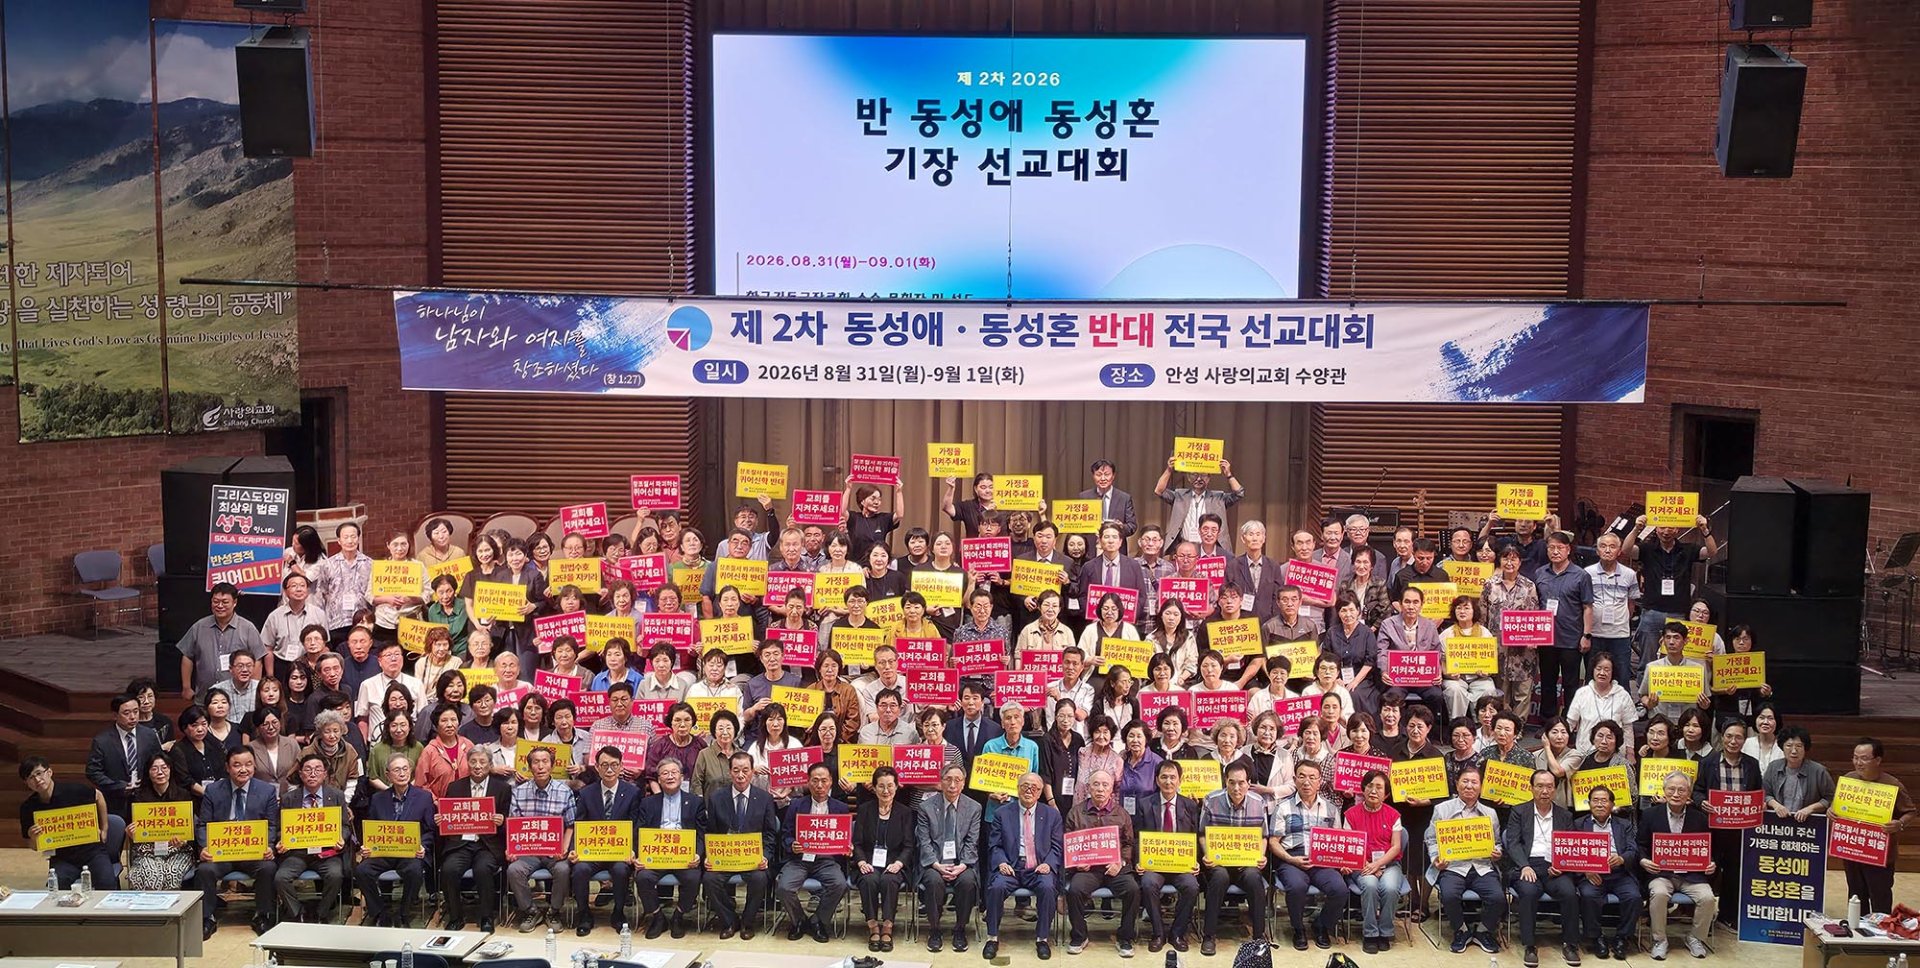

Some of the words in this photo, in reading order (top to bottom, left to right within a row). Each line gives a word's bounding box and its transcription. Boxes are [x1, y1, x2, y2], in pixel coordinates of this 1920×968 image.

[956, 71, 972, 87] 제
[979, 71, 1006, 87] 2차
[1012, 72, 1061, 87] 2026
[856, 98, 892, 137] 반
[910, 98, 1023, 138] 동성애
[1044, 98, 1159, 139] 동성혼
[884, 146, 959, 186] 기장
[978, 147, 1129, 186] 선교대회
[46, 261, 132, 287] 제자되어
[46, 296, 133, 321] 실천하는
[417, 304, 485, 323] 하나님이
[730, 309, 763, 344] 제
[772, 310, 828, 345] 2차
[844, 310, 944, 347] 동성애
[979, 312, 1079, 347] 동성혼
[1089, 312, 1154, 348] 반대
[1164, 313, 1231, 349] 전국
[1240, 313, 1375, 349] 선교대회
[17, 339, 38, 349] that
[42, 337, 70, 348] Lives
[107, 335, 132, 345] Love
[198, 332, 243, 343] Disciples
[245, 332, 254, 340] of
[435, 323, 518, 352] 남자와
[525, 327, 587, 358] 여자를
[512, 359, 599, 381] 창조하셨다
[704, 362, 737, 380] 일시
[758, 364, 819, 382] 2026년
[824, 364, 851, 382] 8월
[856, 365, 961, 384] 31일(월)-9월
[967, 365, 1025, 385] 1일(화)
[604, 374, 617, 386] (창
[619, 374, 641, 386] 1:27)
[1110, 367, 1144, 384] 장소
[1165, 367, 1199, 384] 안성
[1204, 367, 1290, 385] 사랑의교회
[1295, 367, 1347, 385] 수양관
[223, 405, 275, 418] 사랑의교회
[223, 419, 248, 427] SaRang
[252, 417, 275, 425] Church
[939, 448, 961, 456] 가정을
[1177, 452, 1218, 462] 지켜주세요!
[931, 458, 970, 466] 지켜주세요!
[1006, 480, 1029, 488] 가정을
[217, 489, 285, 503] 그리스도인의
[996, 489, 1039, 498] 지켜주세요!
[1510, 489, 1533, 497] 가정을
[806, 494, 829, 503] 교회를
[1500, 498, 1543, 507] 지켜주세요!
[1660, 496, 1684, 504] 가정을
[219, 502, 252, 514] 최상위
[257, 504, 279, 515] 법은
[795, 504, 839, 513] 지켜주세요!
[1065, 504, 1089, 512] 가정을
[1650, 506, 1694, 515] 지켜주세요!
[1056, 513, 1098, 521] 지켜주세요!
[238, 537, 282, 545] SCRIPTURA
[211, 551, 254, 566] 반성경적
[384, 566, 409, 574] 가정을
[375, 575, 418, 585] 지켜주세요!
[1162, 590, 1206, 600] 지켜주세요!
[714, 624, 739, 633] 가정을
[705, 633, 749, 644] 지켜주세요!
[908, 642, 932, 650] 교회를
[898, 652, 942, 661] 지켜주세요!
[1401, 656, 1426, 664] 자녀를
[1727, 657, 1751, 665] 가정을
[1391, 667, 1435, 675] 지켜주세요!
[1717, 667, 1761, 677] 지켜주세요!
[920, 672, 944, 681] 교회를
[1009, 674, 1033, 683] 교회를
[909, 683, 955, 692] 지켜주세요!
[998, 684, 1044, 694] 지켜주세요!
[785, 692, 809, 702] 가정을
[782, 753, 809, 763] 자녀를
[906, 750, 931, 758] 자녀를
[896, 760, 940, 770] 지켜주세요!
[1724, 794, 1752, 804] 교회를
[148, 807, 176, 816] 가정을
[453, 802, 480, 811] 교회를
[1714, 805, 1762, 815] 지켜주세요!
[297, 812, 326, 822] 가정을
[443, 813, 493, 822] 지켜주세요!
[137, 818, 188, 829] 지켜주세요!
[522, 820, 548, 830] 교회를
[811, 818, 837, 829] 자녀를
[223, 825, 252, 835] 가정을
[285, 824, 337, 834] 지켜주세요!
[378, 825, 405, 834] 가정을
[590, 826, 617, 834] 가정을
[1755, 825, 1793, 836] 하나님이
[1797, 827, 1815, 838] 주신
[367, 835, 417, 844] 지켜주세요!
[510, 833, 560, 842] 지켜주세요!
[654, 834, 680, 843] 가정을
[799, 831, 848, 840] 지켜주세요!
[211, 837, 263, 848] 지켜주세요!
[579, 838, 628, 847] 지켜주세요!
[1750, 839, 1778, 850] 가정을
[1781, 840, 1819, 853] 해체하는
[643, 845, 691, 855] 지켜주세요!
[1759, 856, 1809, 876] 동성애
[1751, 879, 1814, 900] 동성혼을
